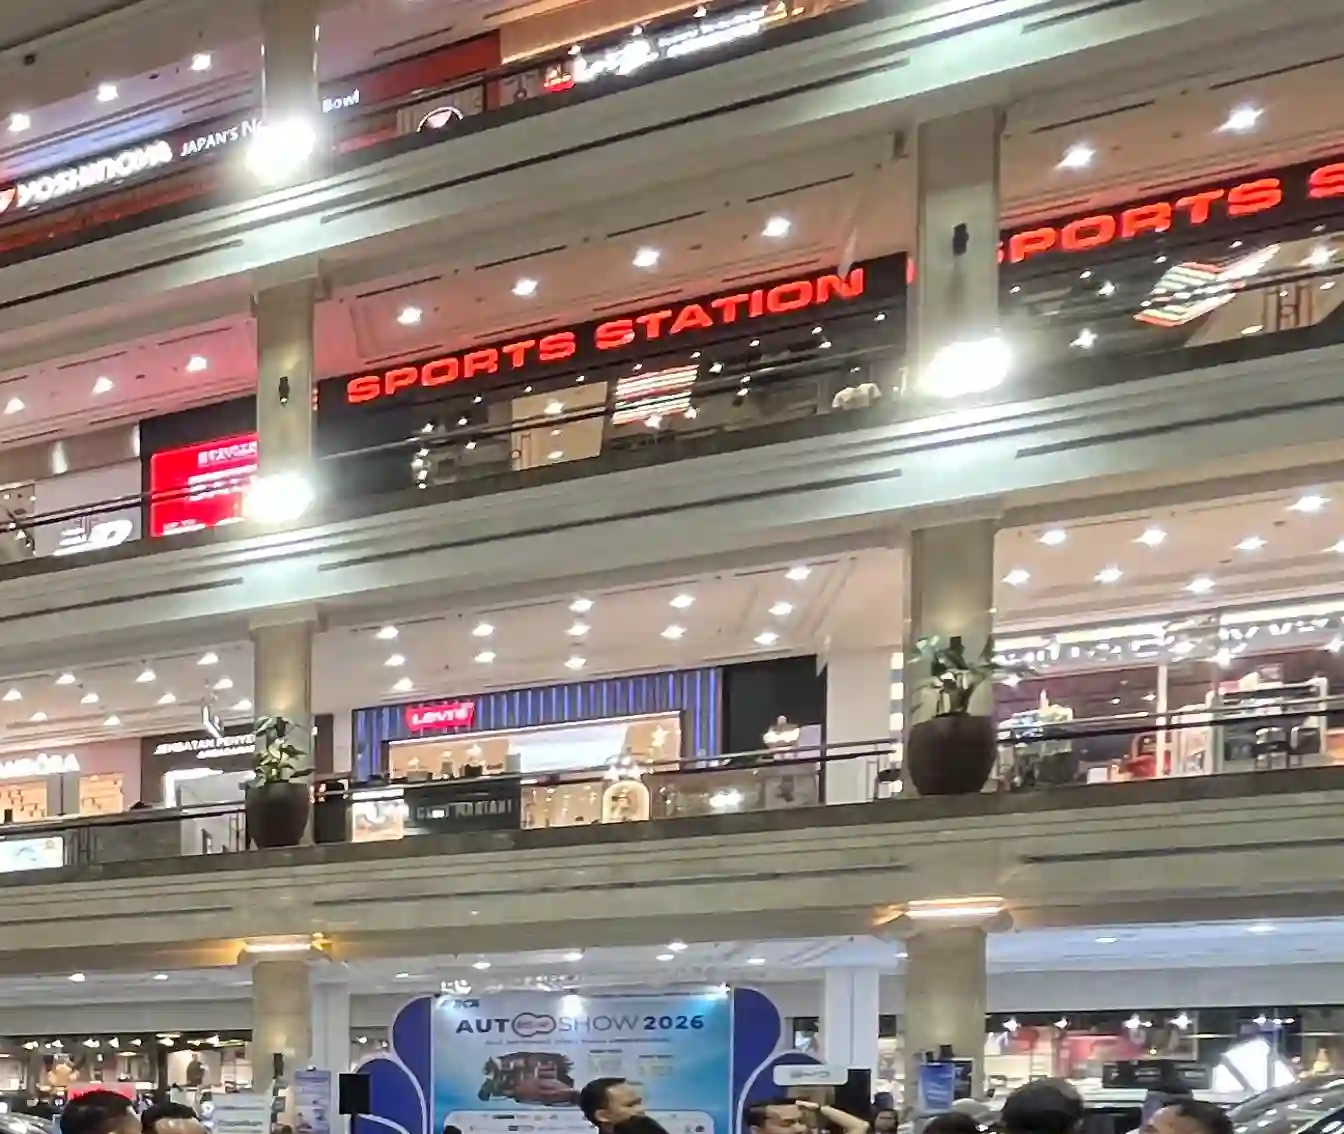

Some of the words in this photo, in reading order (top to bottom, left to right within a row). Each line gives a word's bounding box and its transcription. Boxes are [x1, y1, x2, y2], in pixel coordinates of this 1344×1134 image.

[322, 89, 360, 112] Bowl
[346, 331, 576, 403] SPORTS
[594, 267, 865, 350] STATION
[643, 1014, 705, 1032] 2026
